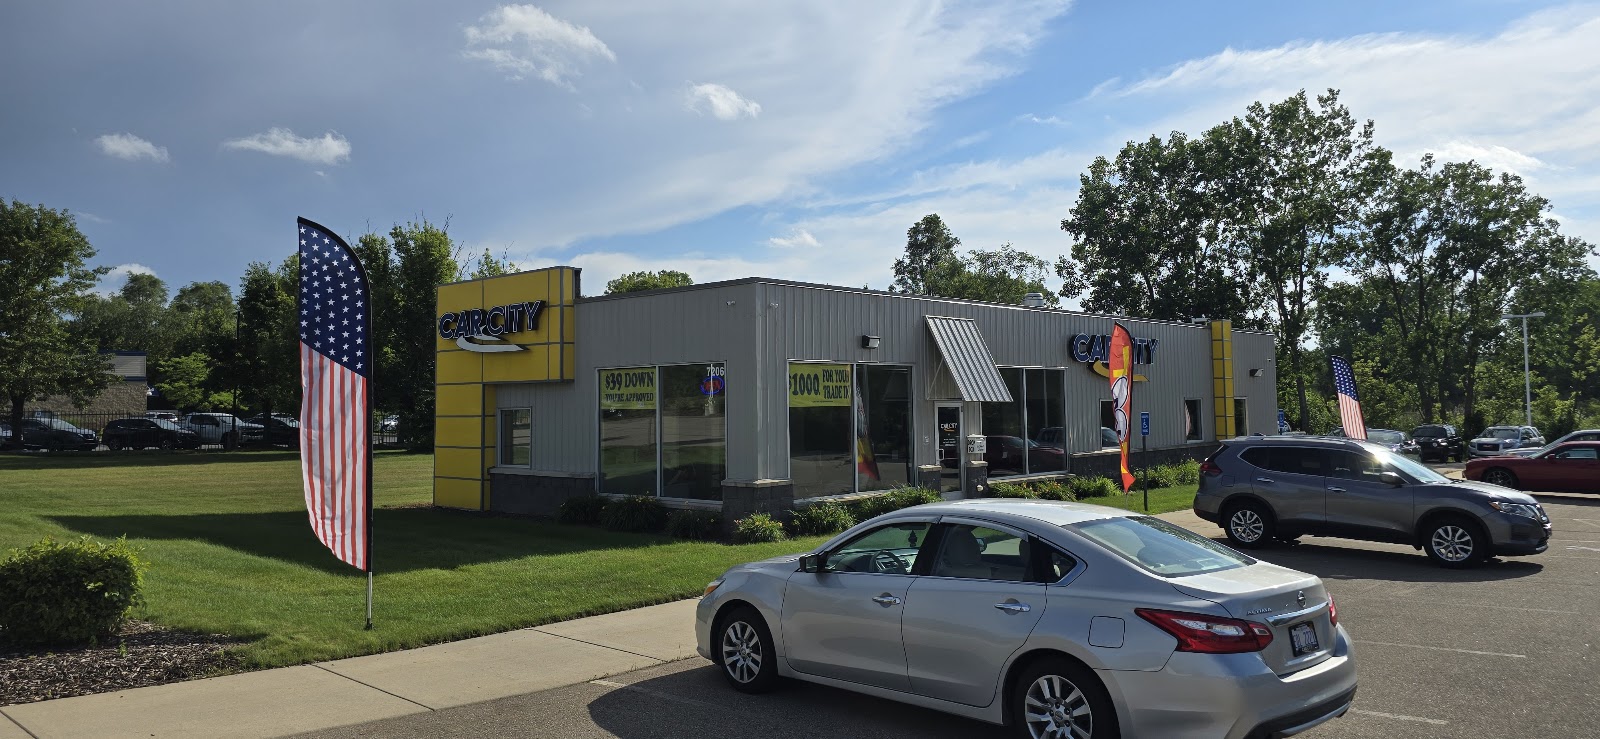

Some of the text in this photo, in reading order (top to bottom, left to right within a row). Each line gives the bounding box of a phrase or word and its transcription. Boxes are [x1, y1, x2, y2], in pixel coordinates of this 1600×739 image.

[439, 300, 543, 339] CAR CITY
[1130, 337, 1159, 365] ITY
[706, 366, 725, 377] 7206
[822, 368, 834, 383] FOR
[605, 371, 654, 391] $39 DOWN
[625, 392, 654, 402] APPROVED
[823, 385, 842, 399] TRADE
